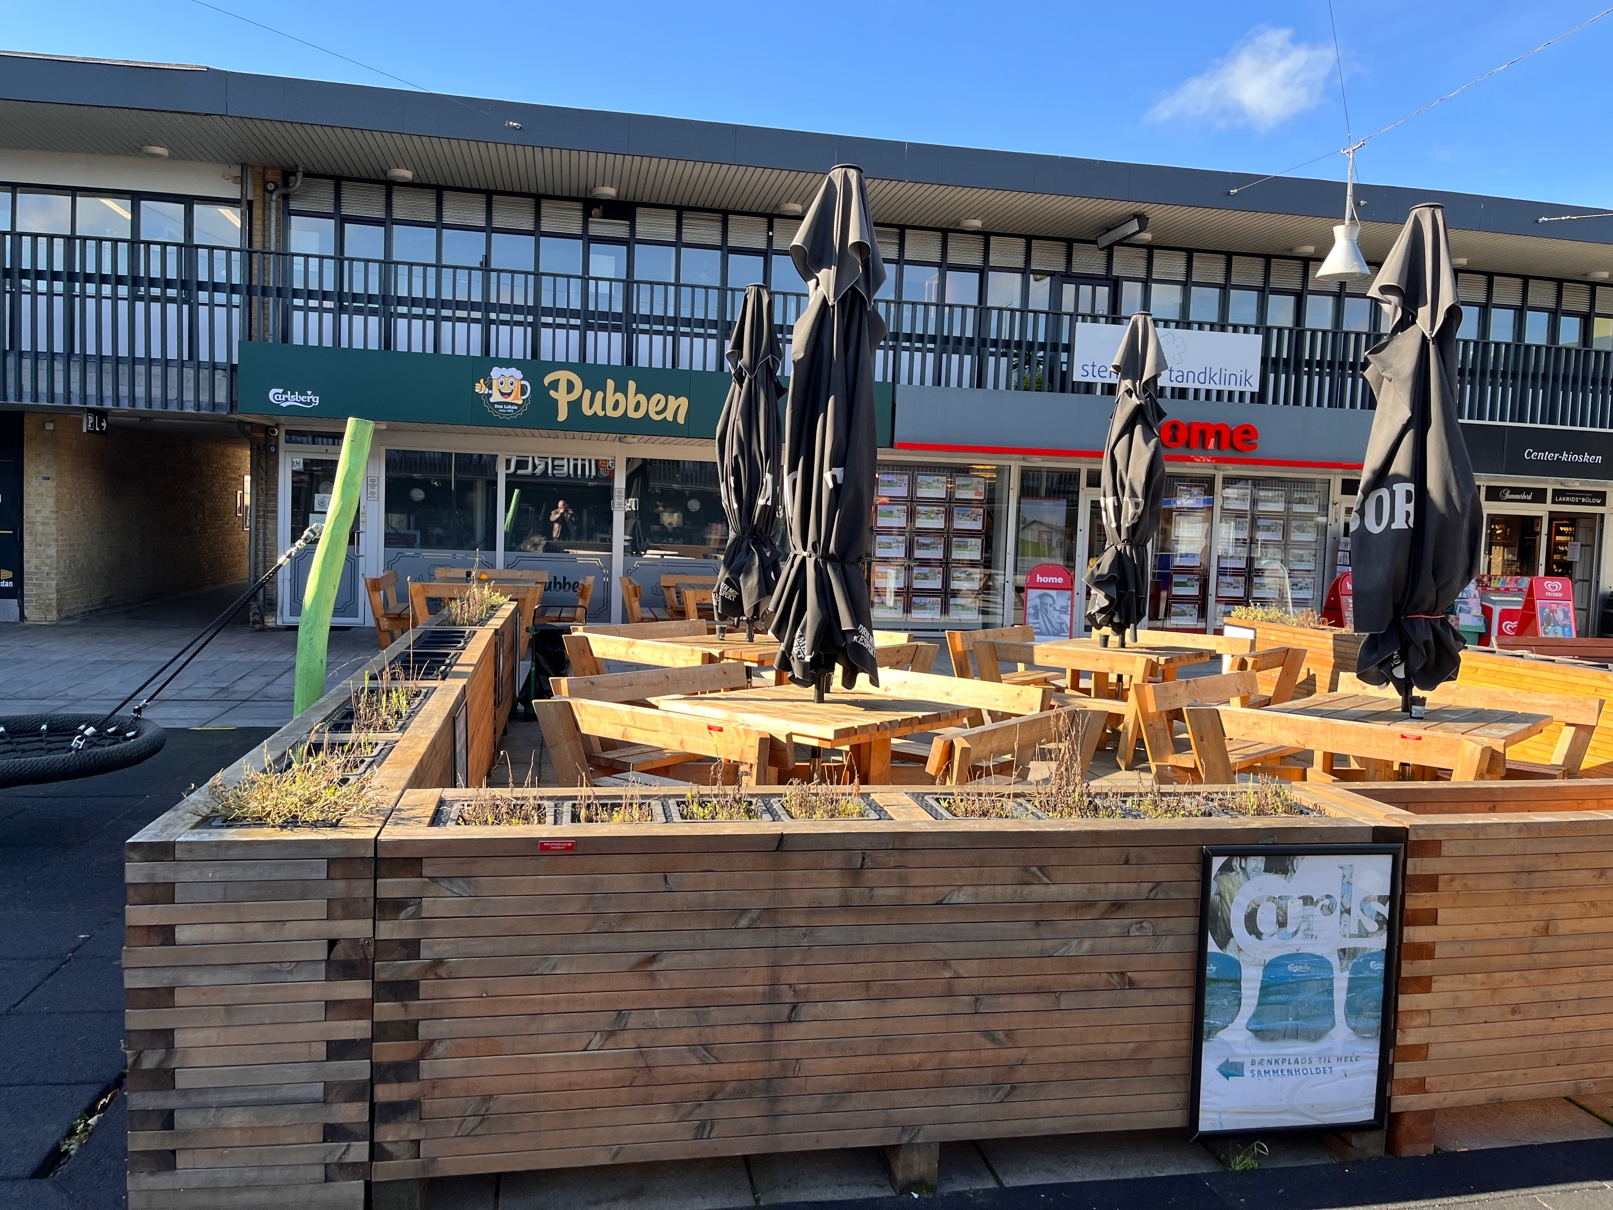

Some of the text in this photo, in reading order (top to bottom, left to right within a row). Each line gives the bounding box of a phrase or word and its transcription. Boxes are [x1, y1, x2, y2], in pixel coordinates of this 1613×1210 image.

[1081, 361, 1119, 379] sten
[1169, 366, 1253, 387] tandklinik
[268, 387, 320, 408] Carlsberg
[543, 369, 689, 424] Pubben
[1159, 419, 1259, 452] ome
[1524, 448, 1602, 464] Center-kiosken
[544, 576, 580, 593] ubbe
[1036, 574, 1064, 584] home
[1250, 1056, 1313, 1066] BÆNKPLADS
[1318, 1056, 1332, 1064] TIL
[1250, 1066, 1334, 1077] SAMMENHOLDET
